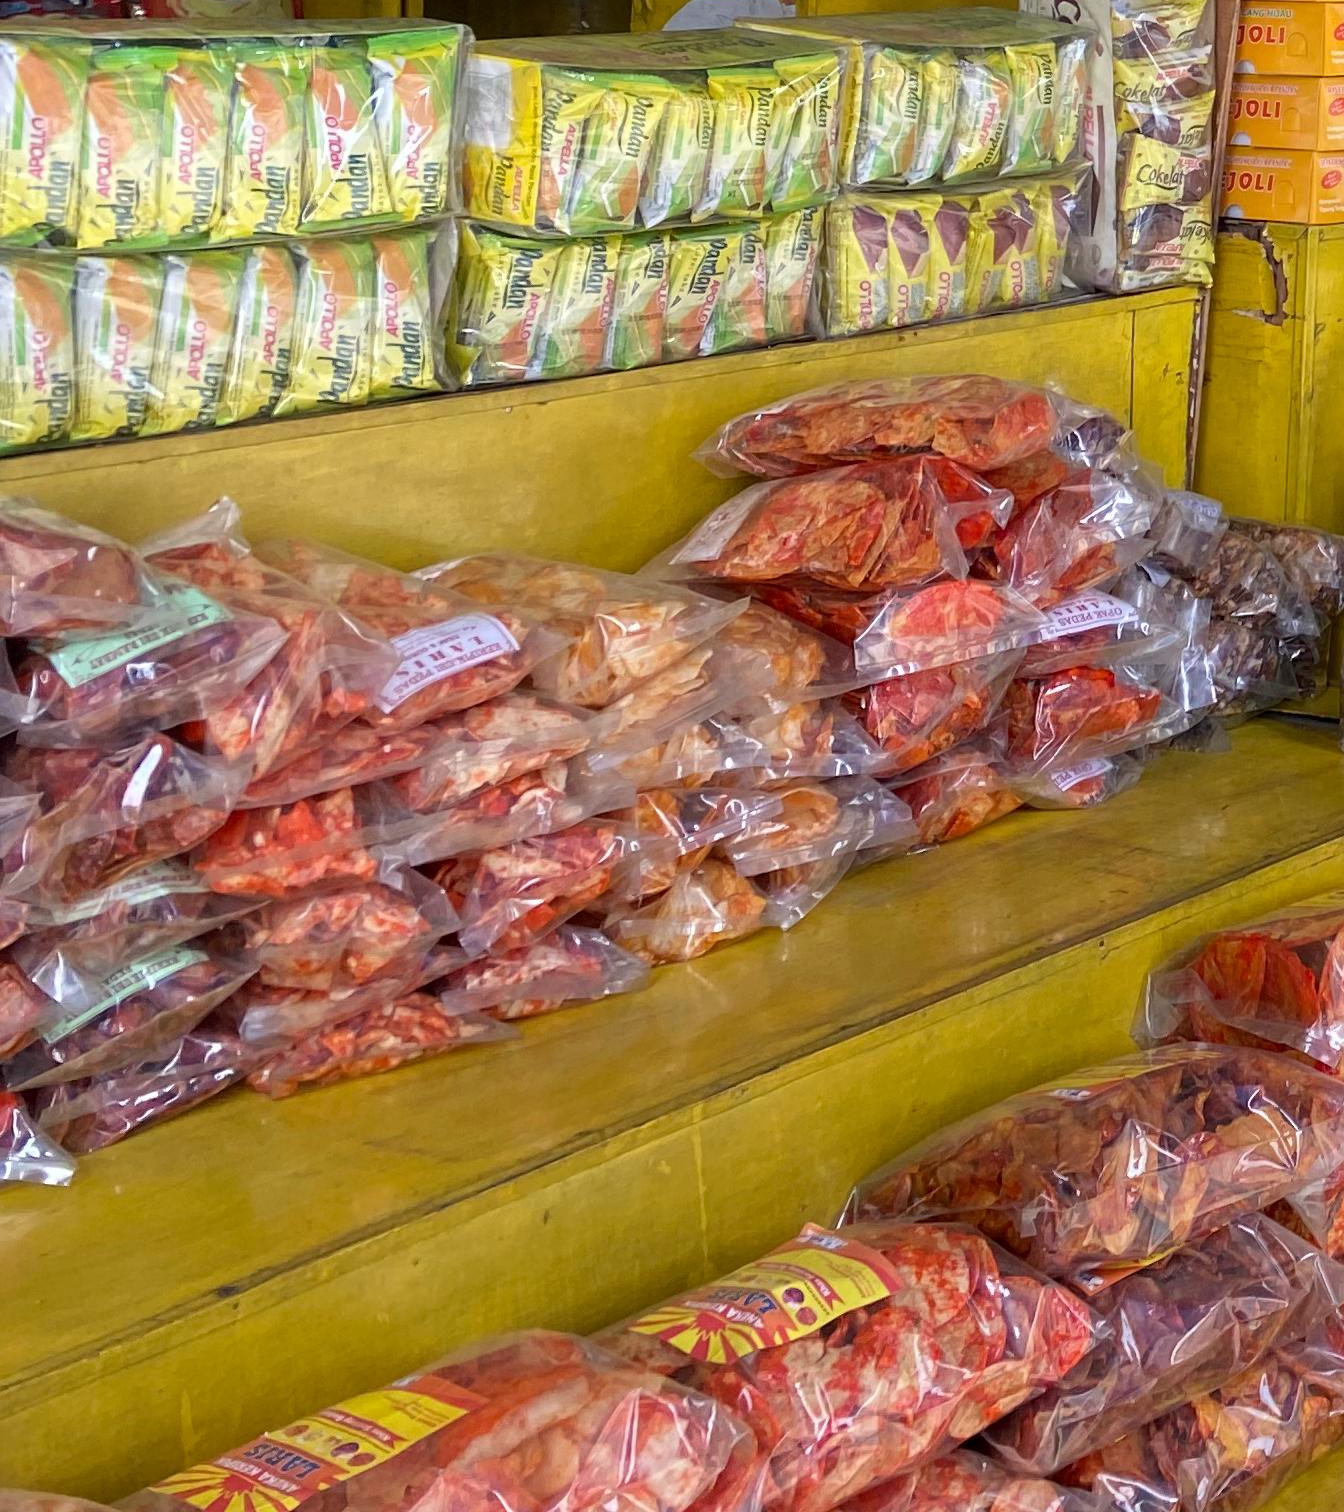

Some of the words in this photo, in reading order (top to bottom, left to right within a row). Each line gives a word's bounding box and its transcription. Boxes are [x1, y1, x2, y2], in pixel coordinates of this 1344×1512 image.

[1236, 24, 1287, 45] JOLI
[622, 95, 654, 159] Pandan
[1228, 98, 1282, 120] JOLI
[28, 116, 48, 180] APOLLO
[96, 136, 112, 199] APOLLO
[178, 124, 195, 186] APOLLO
[248, 123, 267, 184] APOLLO
[1136, 163, 1185, 186] Cokelat
[505, 247, 543, 310] Pandan
[690, 237, 726, 295] Pandan
[262, 305, 279, 366] APOLLO
[322, 292, 340, 352] APOLLO
[385, 281, 398, 338] APOLLO
[521, 291, 540, 342] APOLLO
[111, 323, 132, 385] APOLLO
[187, 319, 207, 381] APOLLO
[1057, 611, 1093, 627] PEDAS
[243, 1443, 321, 1480] LARIS
